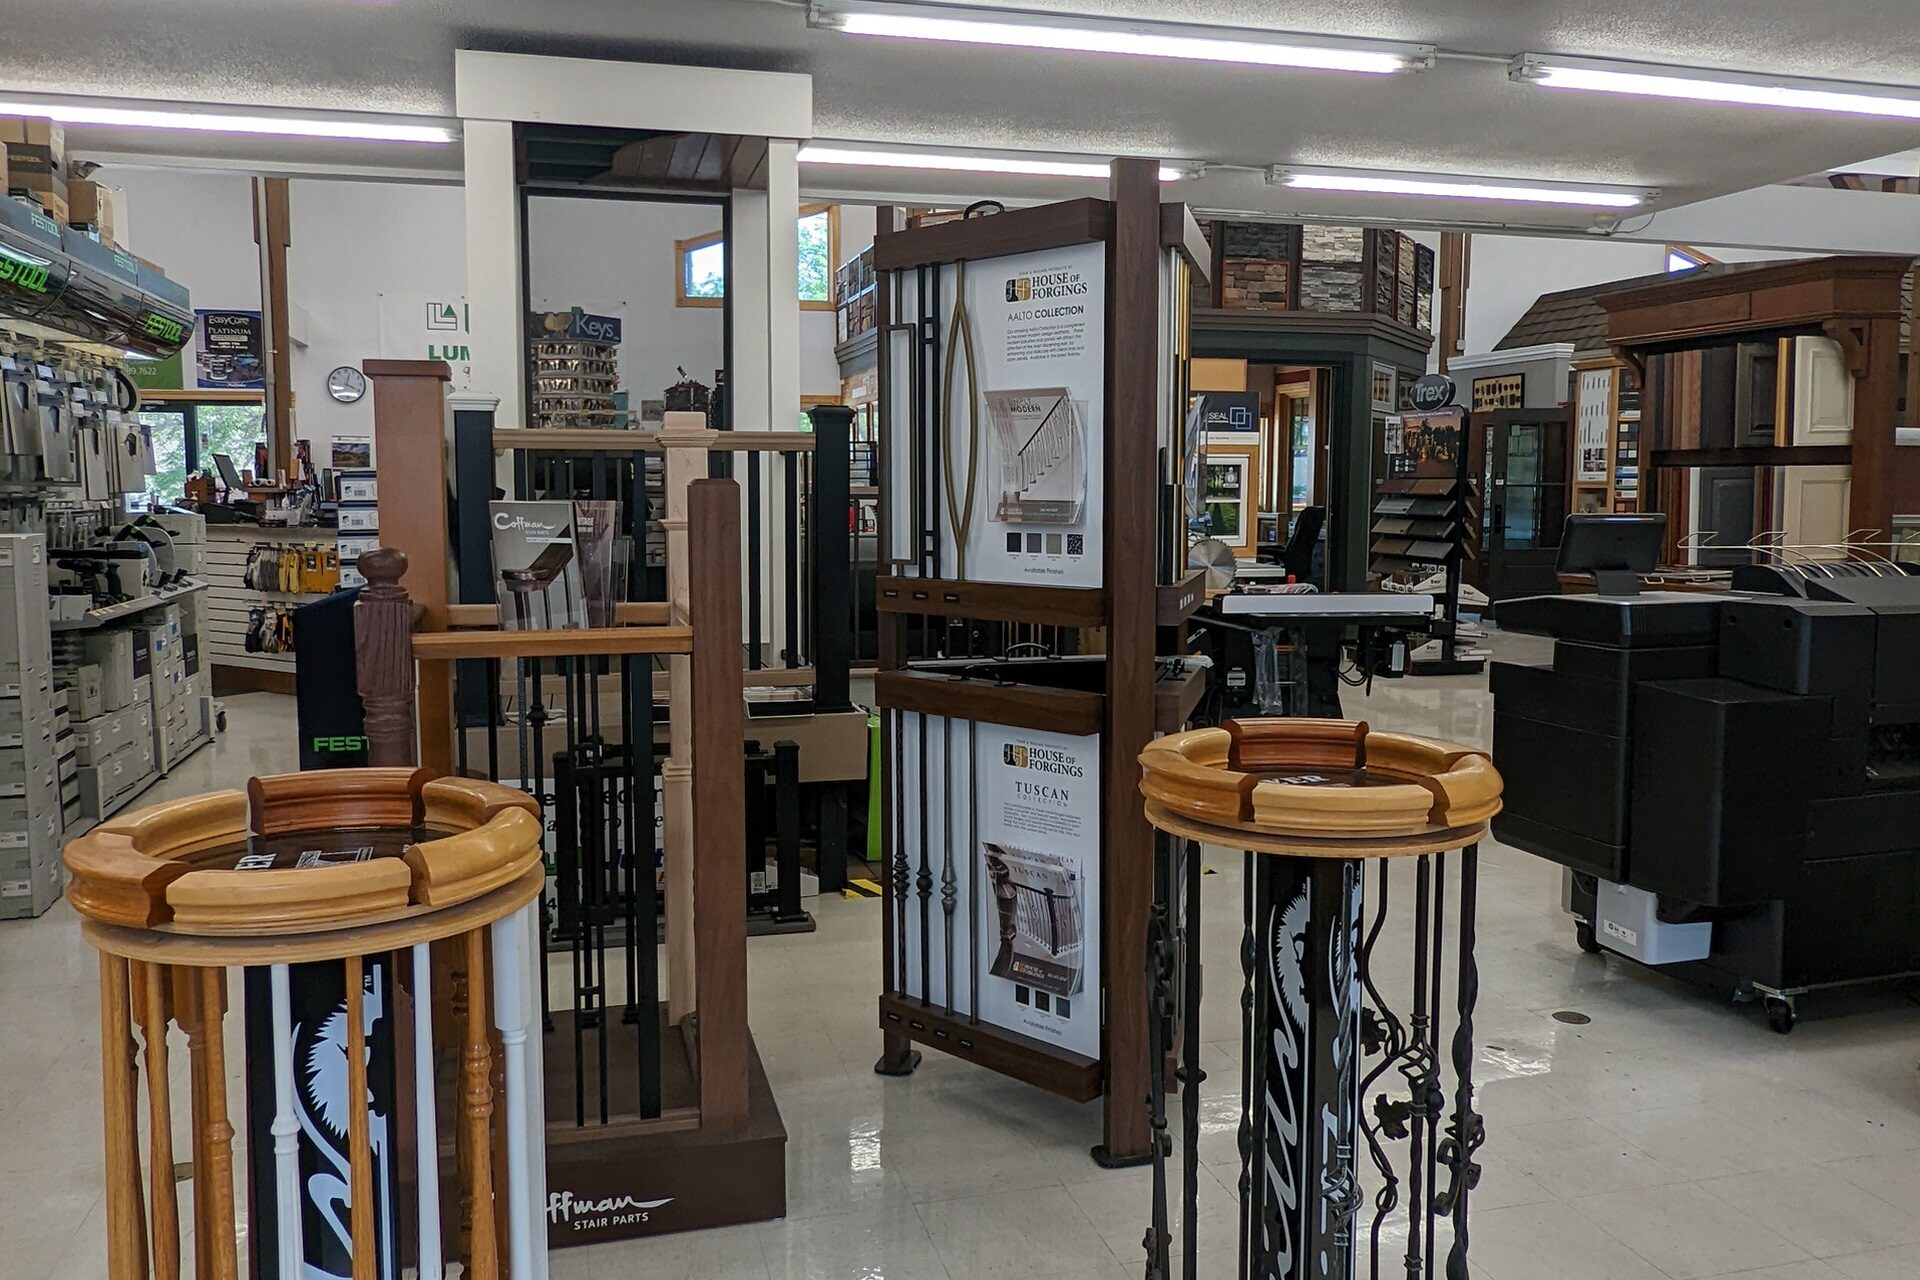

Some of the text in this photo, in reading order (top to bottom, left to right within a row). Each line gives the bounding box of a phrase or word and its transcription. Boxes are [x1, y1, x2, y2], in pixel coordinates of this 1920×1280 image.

[1032, 272, 1081, 288] HOUSE OF
[1032, 282, 1088, 300] FORGINGS
[208, 315, 250, 325] EasyCare
[1008, 305, 1084, 321] AALTO COLLECTION
[144, 312, 184, 342] FESTOOL
[208, 327, 252, 335] PLATINUM
[575, 315, 614, 339] Keys
[1415, 383, 1446, 402] Trex
[1010, 405, 1041, 413] MODERN
[494, 512, 556, 531] Coffman
[1029, 748, 1076, 765] HOUSE OF
[1029, 759, 1083, 777] FORGINGS
[1015, 781, 1069, 801] TUSCAN
[1017, 793, 1068, 807] COLLECTION
[574, 1211, 649, 1230] STAIR PARTS
